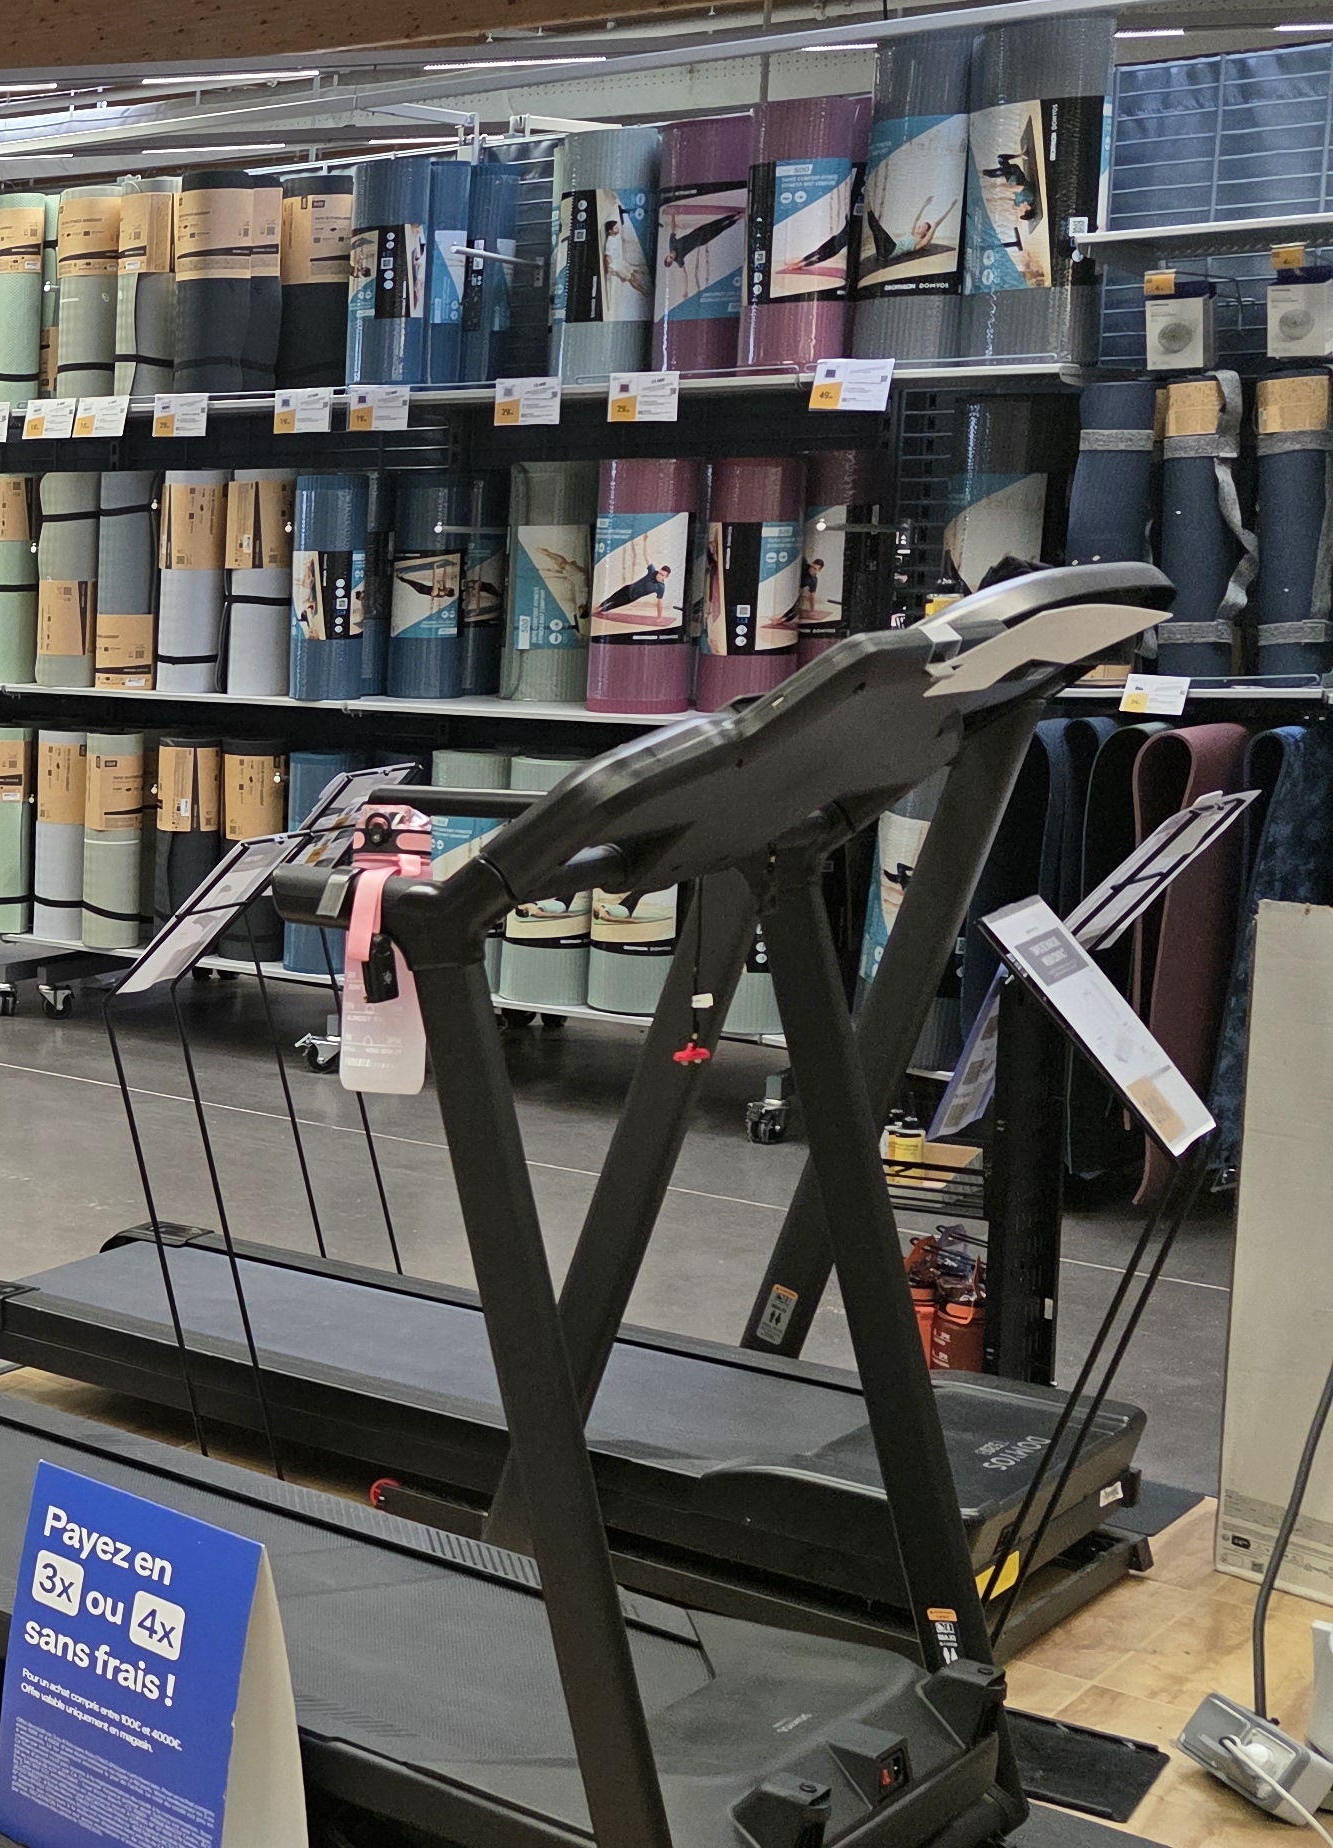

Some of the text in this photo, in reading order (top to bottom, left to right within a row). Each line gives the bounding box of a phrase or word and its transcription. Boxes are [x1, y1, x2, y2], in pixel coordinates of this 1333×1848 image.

[983, 1435, 1051, 1471] DOMYOS
[43, 1505, 172, 1586] Payez en
[39, 1562, 176, 1649] 3x ou 4x
[24, 1620, 176, 1707] sans frais !
[21, 1682, 40, 1698] Offre
[41, 1693, 65, 1711] valable
[66, 1704, 109, 1732] uniquement
[109, 1727, 119, 1736] en
[22, 1668, 39, 1683] Pour
[39, 1678, 49, 1688] un
[50, 1683, 71, 1698] achat
[71, 1692, 99, 1712] compris
[100, 1707, 120, 1721] entre
[121, 1714, 141, 1732] 100€
[141, 1726, 150, 1736] et
